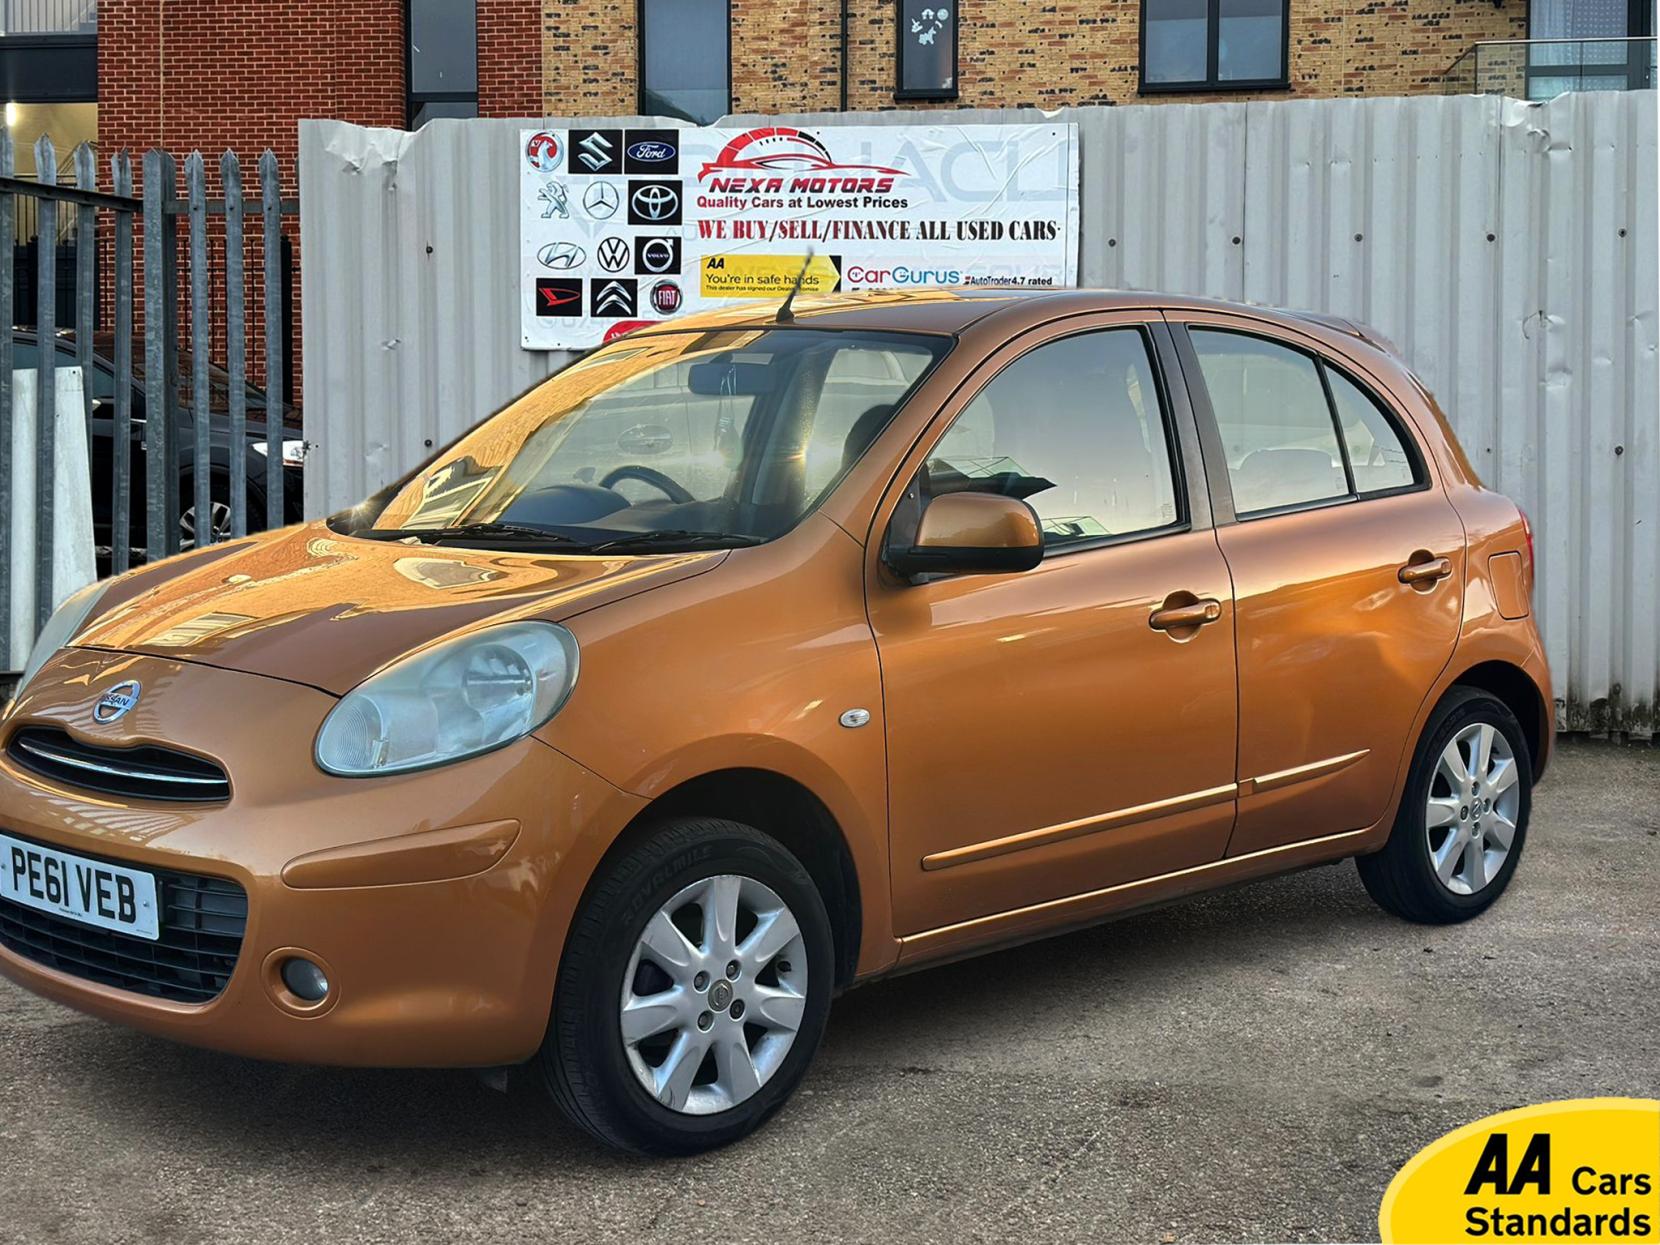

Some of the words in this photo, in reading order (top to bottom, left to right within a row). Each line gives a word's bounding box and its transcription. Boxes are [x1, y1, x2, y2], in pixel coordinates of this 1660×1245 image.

[636, 144, 667, 158] Ford
[709, 177, 784, 193] NEXA
[789, 177, 894, 193] MOTORS
[697, 196, 747, 210] Quality
[751, 196, 783, 208] Cars
[788, 197, 802, 208] at
[807, 197, 858, 208] Lowest
[863, 196, 908, 208] Prices
[697, 220, 727, 239] WE
[916, 221, 951, 240] ALL
[956, 221, 1004, 240] USED
[1009, 221, 1057, 240] CARS
[706, 258, 725, 269] AA
[706, 273, 741, 285] You're
[744, 273, 755, 284] in
[757, 273, 781, 285] safe
[847, 266, 960, 284] CarGurus
[1028, 276, 1053, 285] rated
[658, 290, 677, 306] FIAT
[11, 846, 69, 907] PE61
[75, 864, 136, 924] VEB
